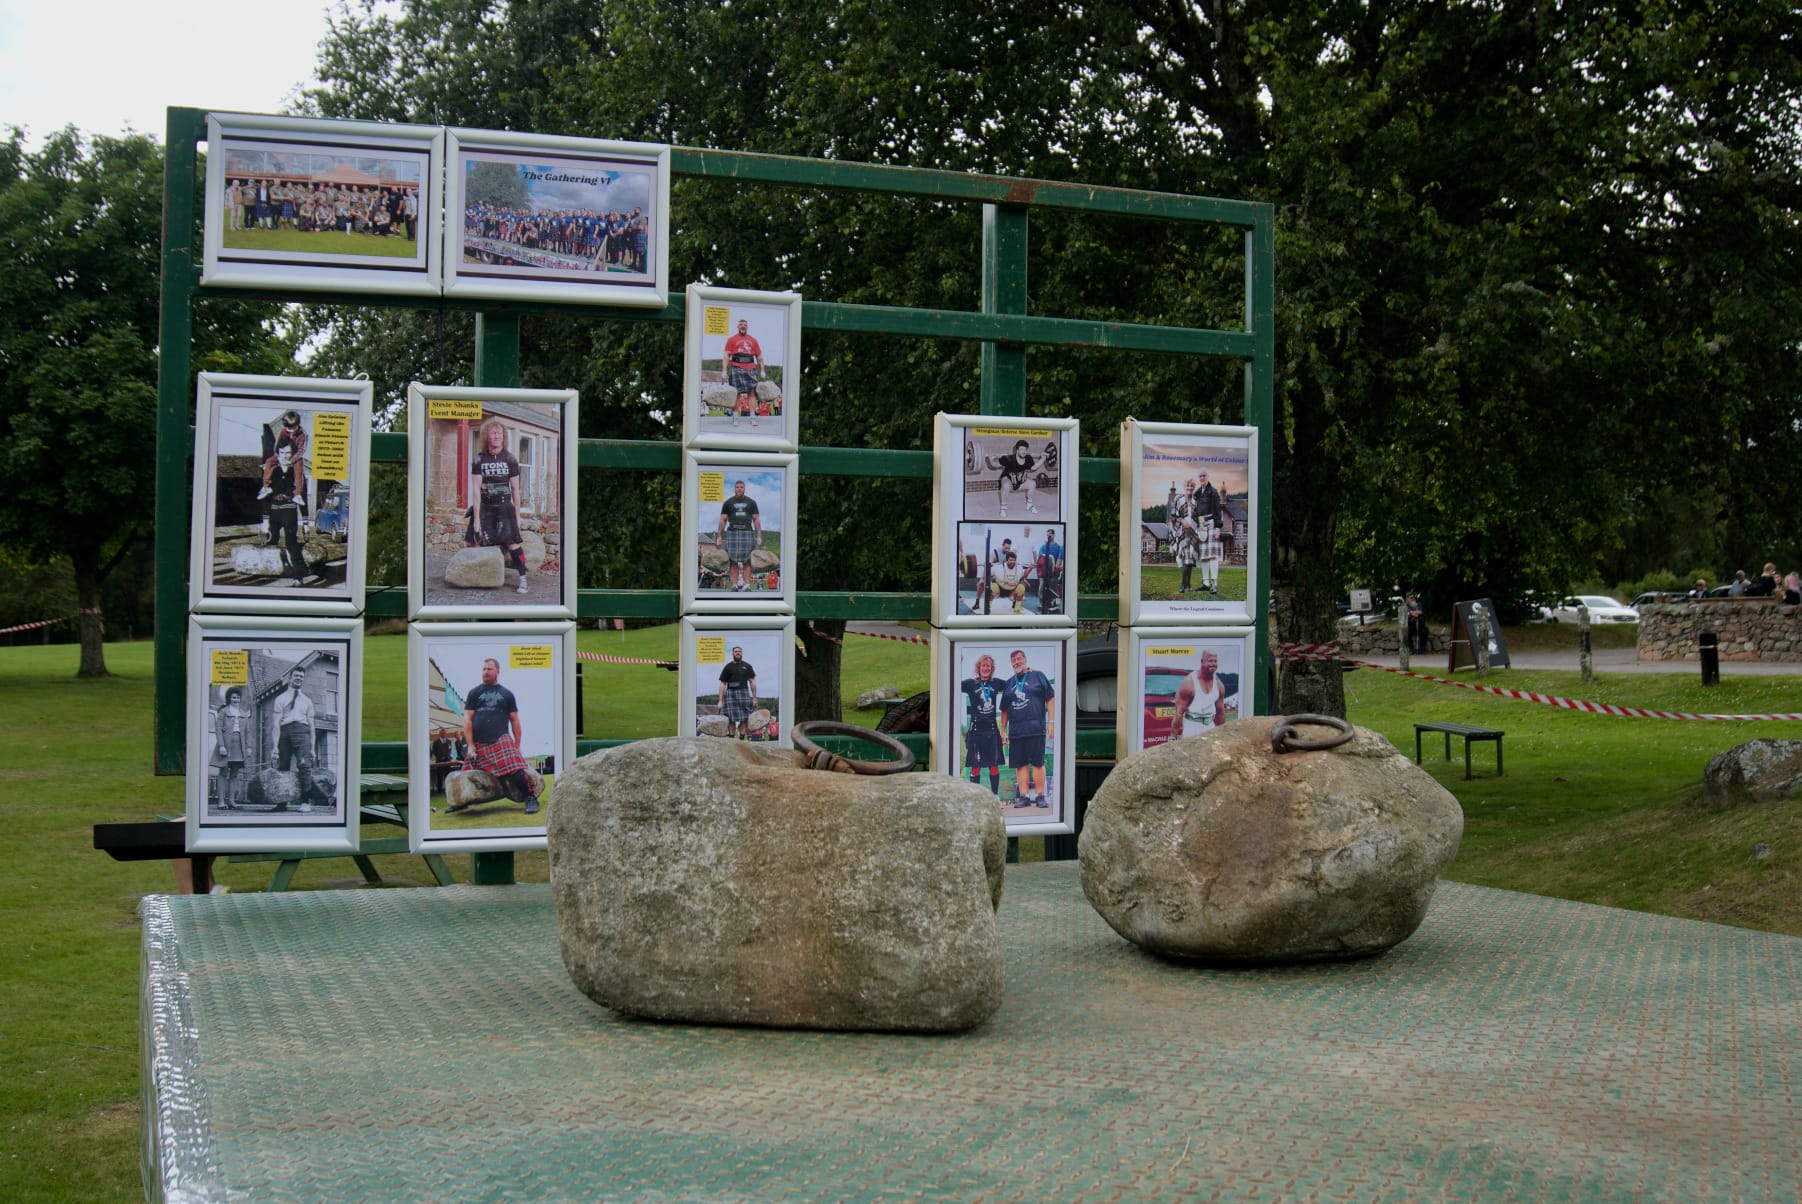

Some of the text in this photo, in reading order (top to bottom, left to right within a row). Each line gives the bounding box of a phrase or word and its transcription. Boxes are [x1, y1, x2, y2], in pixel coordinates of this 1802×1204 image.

[523, 171, 611, 186] The Gathering VI
[1170, 648, 1190, 656] Murray
